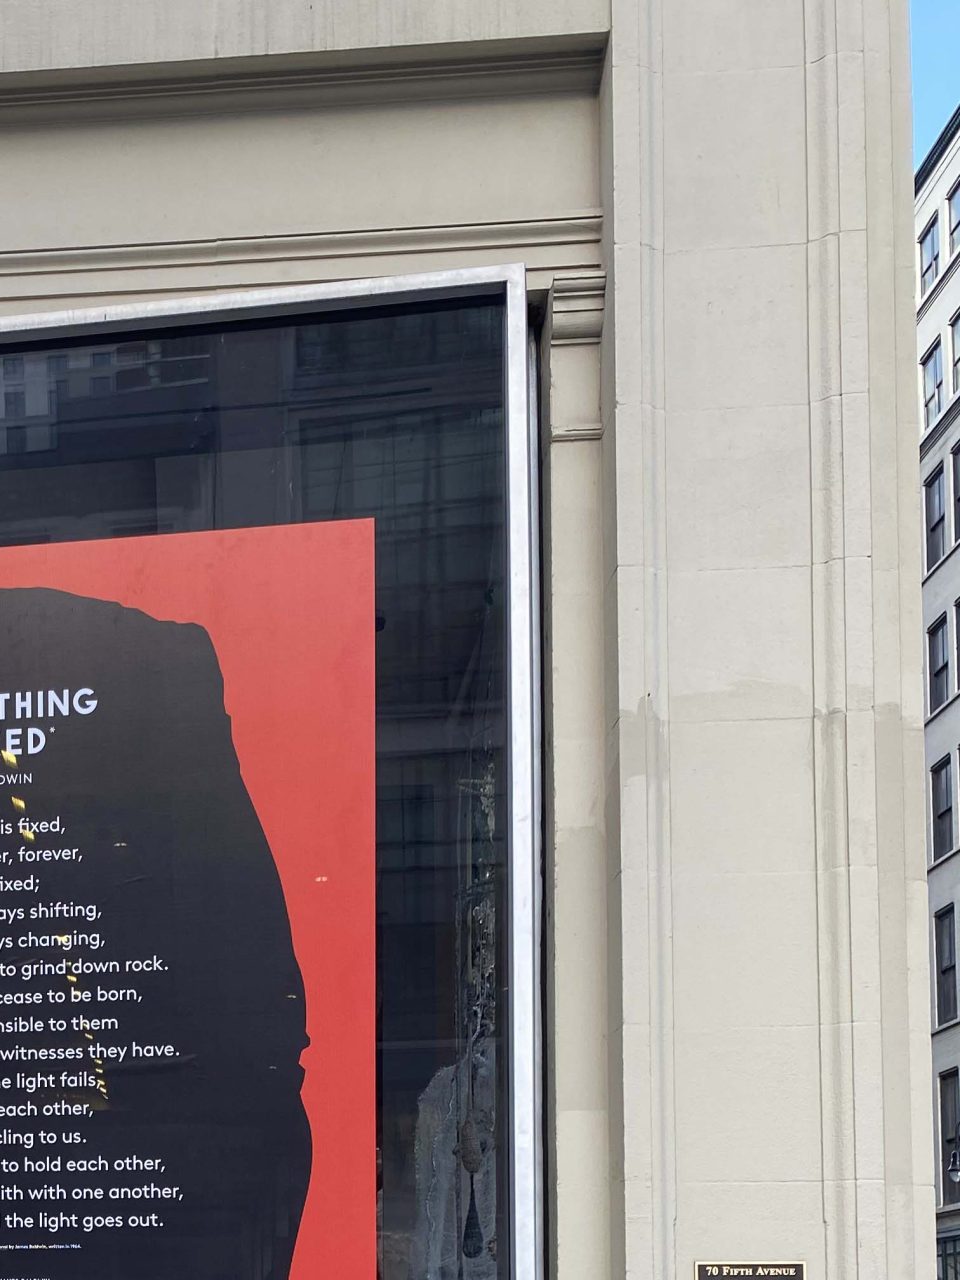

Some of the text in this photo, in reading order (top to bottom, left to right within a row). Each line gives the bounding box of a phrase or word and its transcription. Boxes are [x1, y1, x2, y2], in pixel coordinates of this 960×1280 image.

[1, 819, 12, 834] is
[18, 816, 65, 835] fixed,
[18, 847, 82, 862] forever,
[30, 902, 101, 921] shifting,
[18, 930, 105, 950] changing,
[21, 961, 66, 981] grind
[72, 957, 120, 973] down
[126, 955, 169, 972] rock.
[47, 990, 65, 1003] to
[71, 987, 91, 1002] be
[98, 986, 142, 1002] born,
[48, 1018, 66, 1031] to
[71, 1015, 118, 1032] them
[0, 1045, 83, 1060] witnesses
[88, 1043, 127, 1064] they
[133, 1042, 179, 1057] have.
[17, 1073, 55, 1092] light
[43, 1100, 93, 1117] other,
[39, 1131, 57, 1143] to
[63, 1133, 86, 1143] us.
[1, 1159, 19, 1172] to
[25, 1156, 60, 1171] hold
[67, 1156, 108, 1171] each
[114, 1155, 165, 1172] other,
[28, 1184, 66, 1199] with
[72, 1188, 103, 1199] one
[109, 1183, 183, 1200] another,
[5, 1213, 33, 1228] the
[40, 1212, 78, 1232] light
[83, 1216, 123, 1232] goes
[128, 1214, 163, 1226] out.
[706, 1266, 719, 1276] 70
